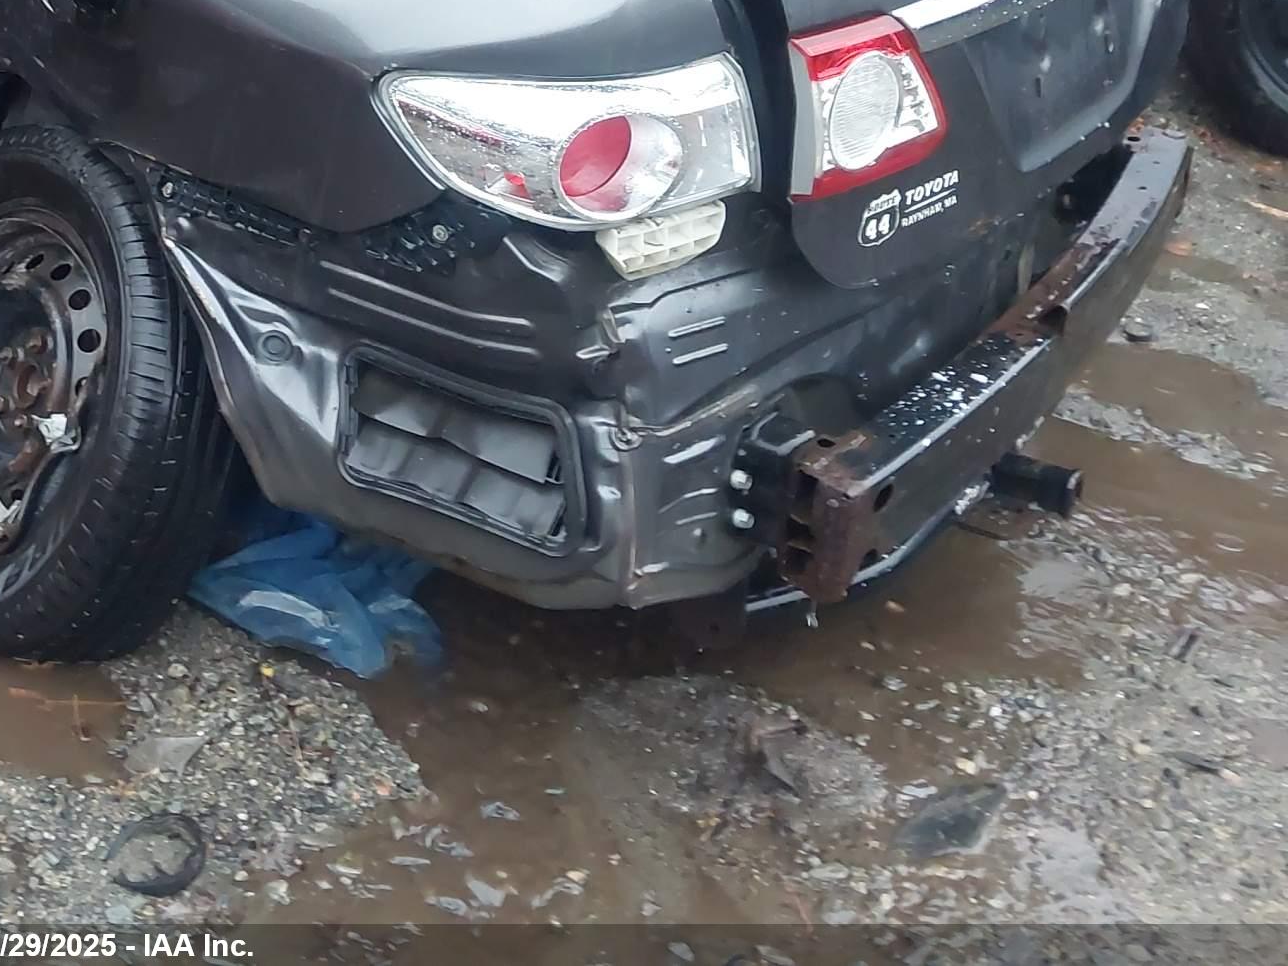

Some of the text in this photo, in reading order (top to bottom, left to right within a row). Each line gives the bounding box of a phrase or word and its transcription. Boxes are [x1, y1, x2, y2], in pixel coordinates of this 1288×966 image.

[905, 170, 959, 205] TOYOTA
[944, 195, 957, 208] MA
[865, 214, 890, 240] 44
